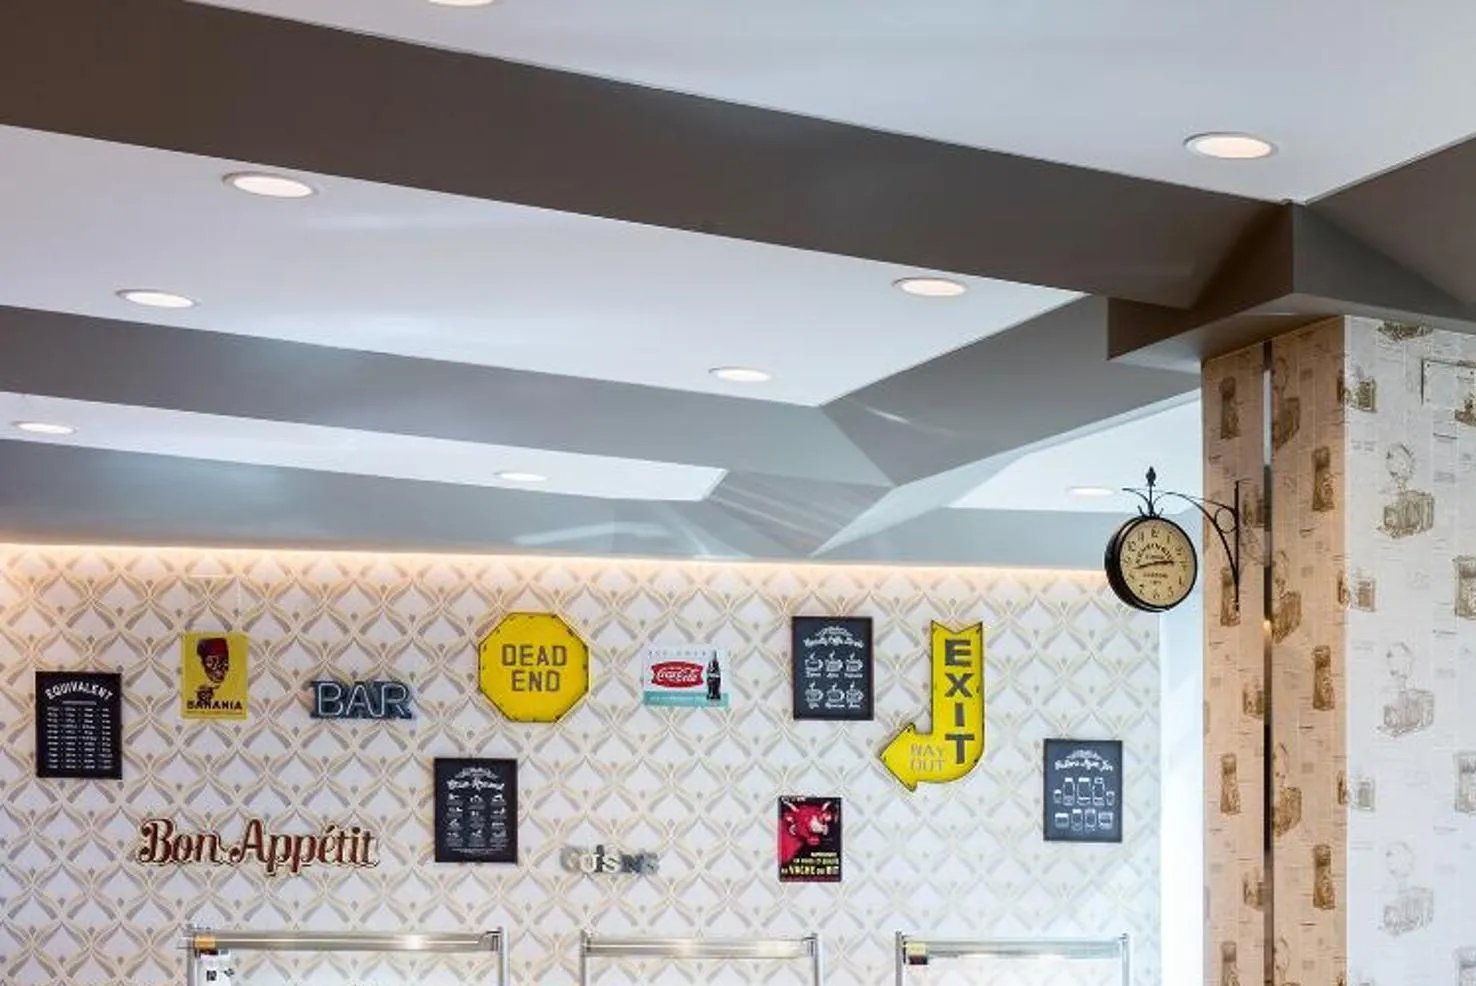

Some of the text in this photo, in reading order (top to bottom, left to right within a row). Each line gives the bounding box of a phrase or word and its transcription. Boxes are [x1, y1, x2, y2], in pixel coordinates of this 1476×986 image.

[502, 644, 568, 666] DEAD
[45, 681, 113, 700] EQUIVALENT
[511, 670, 560, 692] END
[314, 681, 411, 718] BAR
[944, 639, 975, 765] EXIT
[910, 743, 945, 757] WAY
[910, 759, 945, 772] OUT
[137, 818, 379, 876] Bon Appétit
